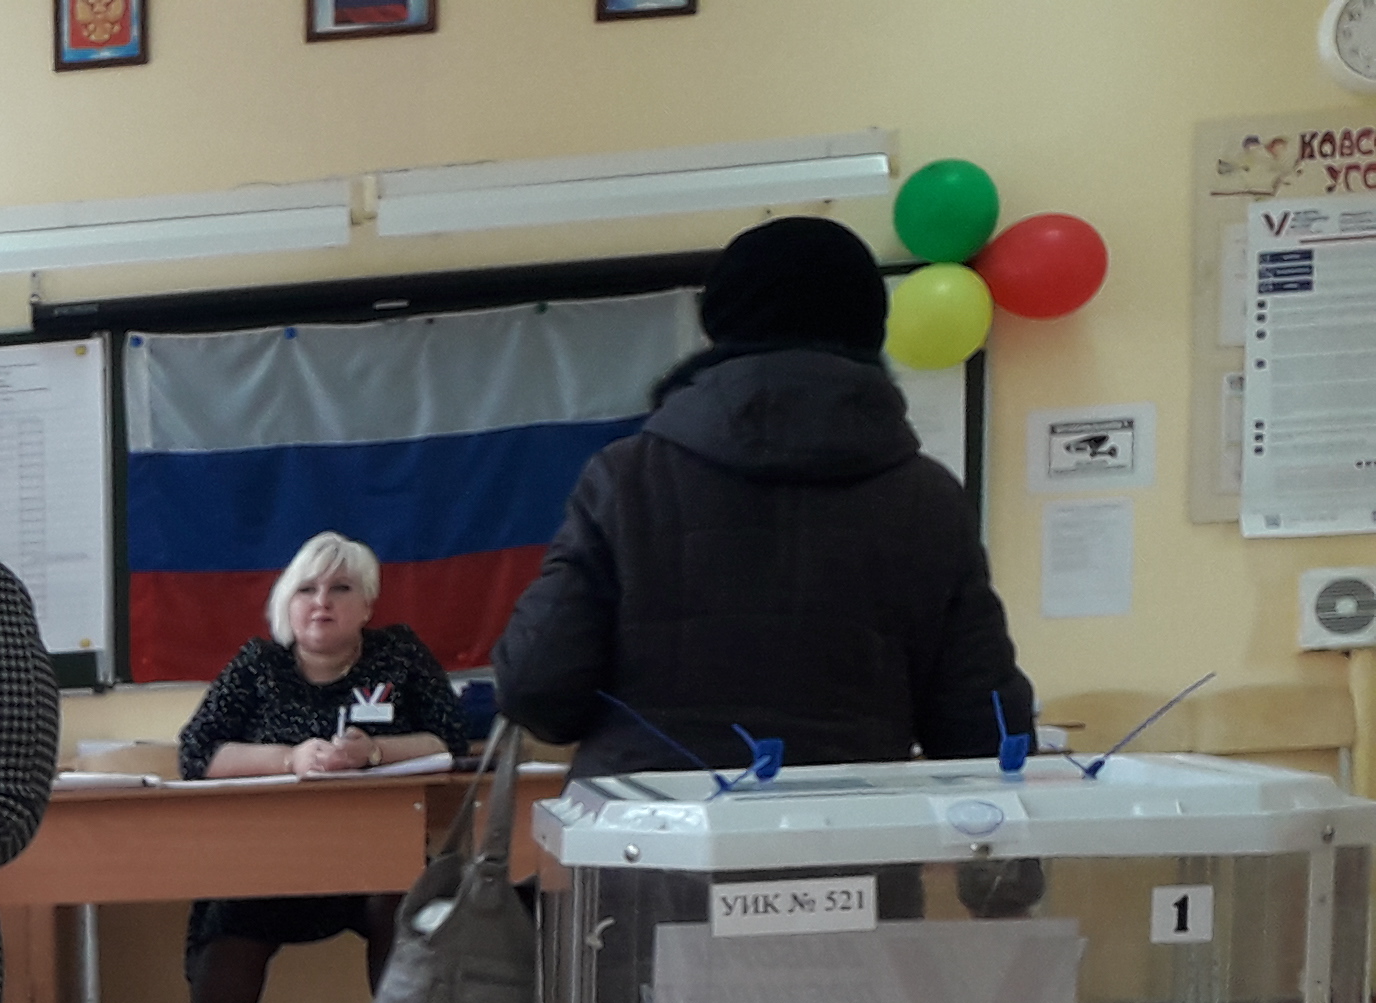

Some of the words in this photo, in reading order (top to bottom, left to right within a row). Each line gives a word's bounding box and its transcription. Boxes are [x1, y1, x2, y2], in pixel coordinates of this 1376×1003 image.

[721, 893, 781, 916] УИК
[824, 890, 863, 912] 521
[1172, 894, 1189, 933] 1
